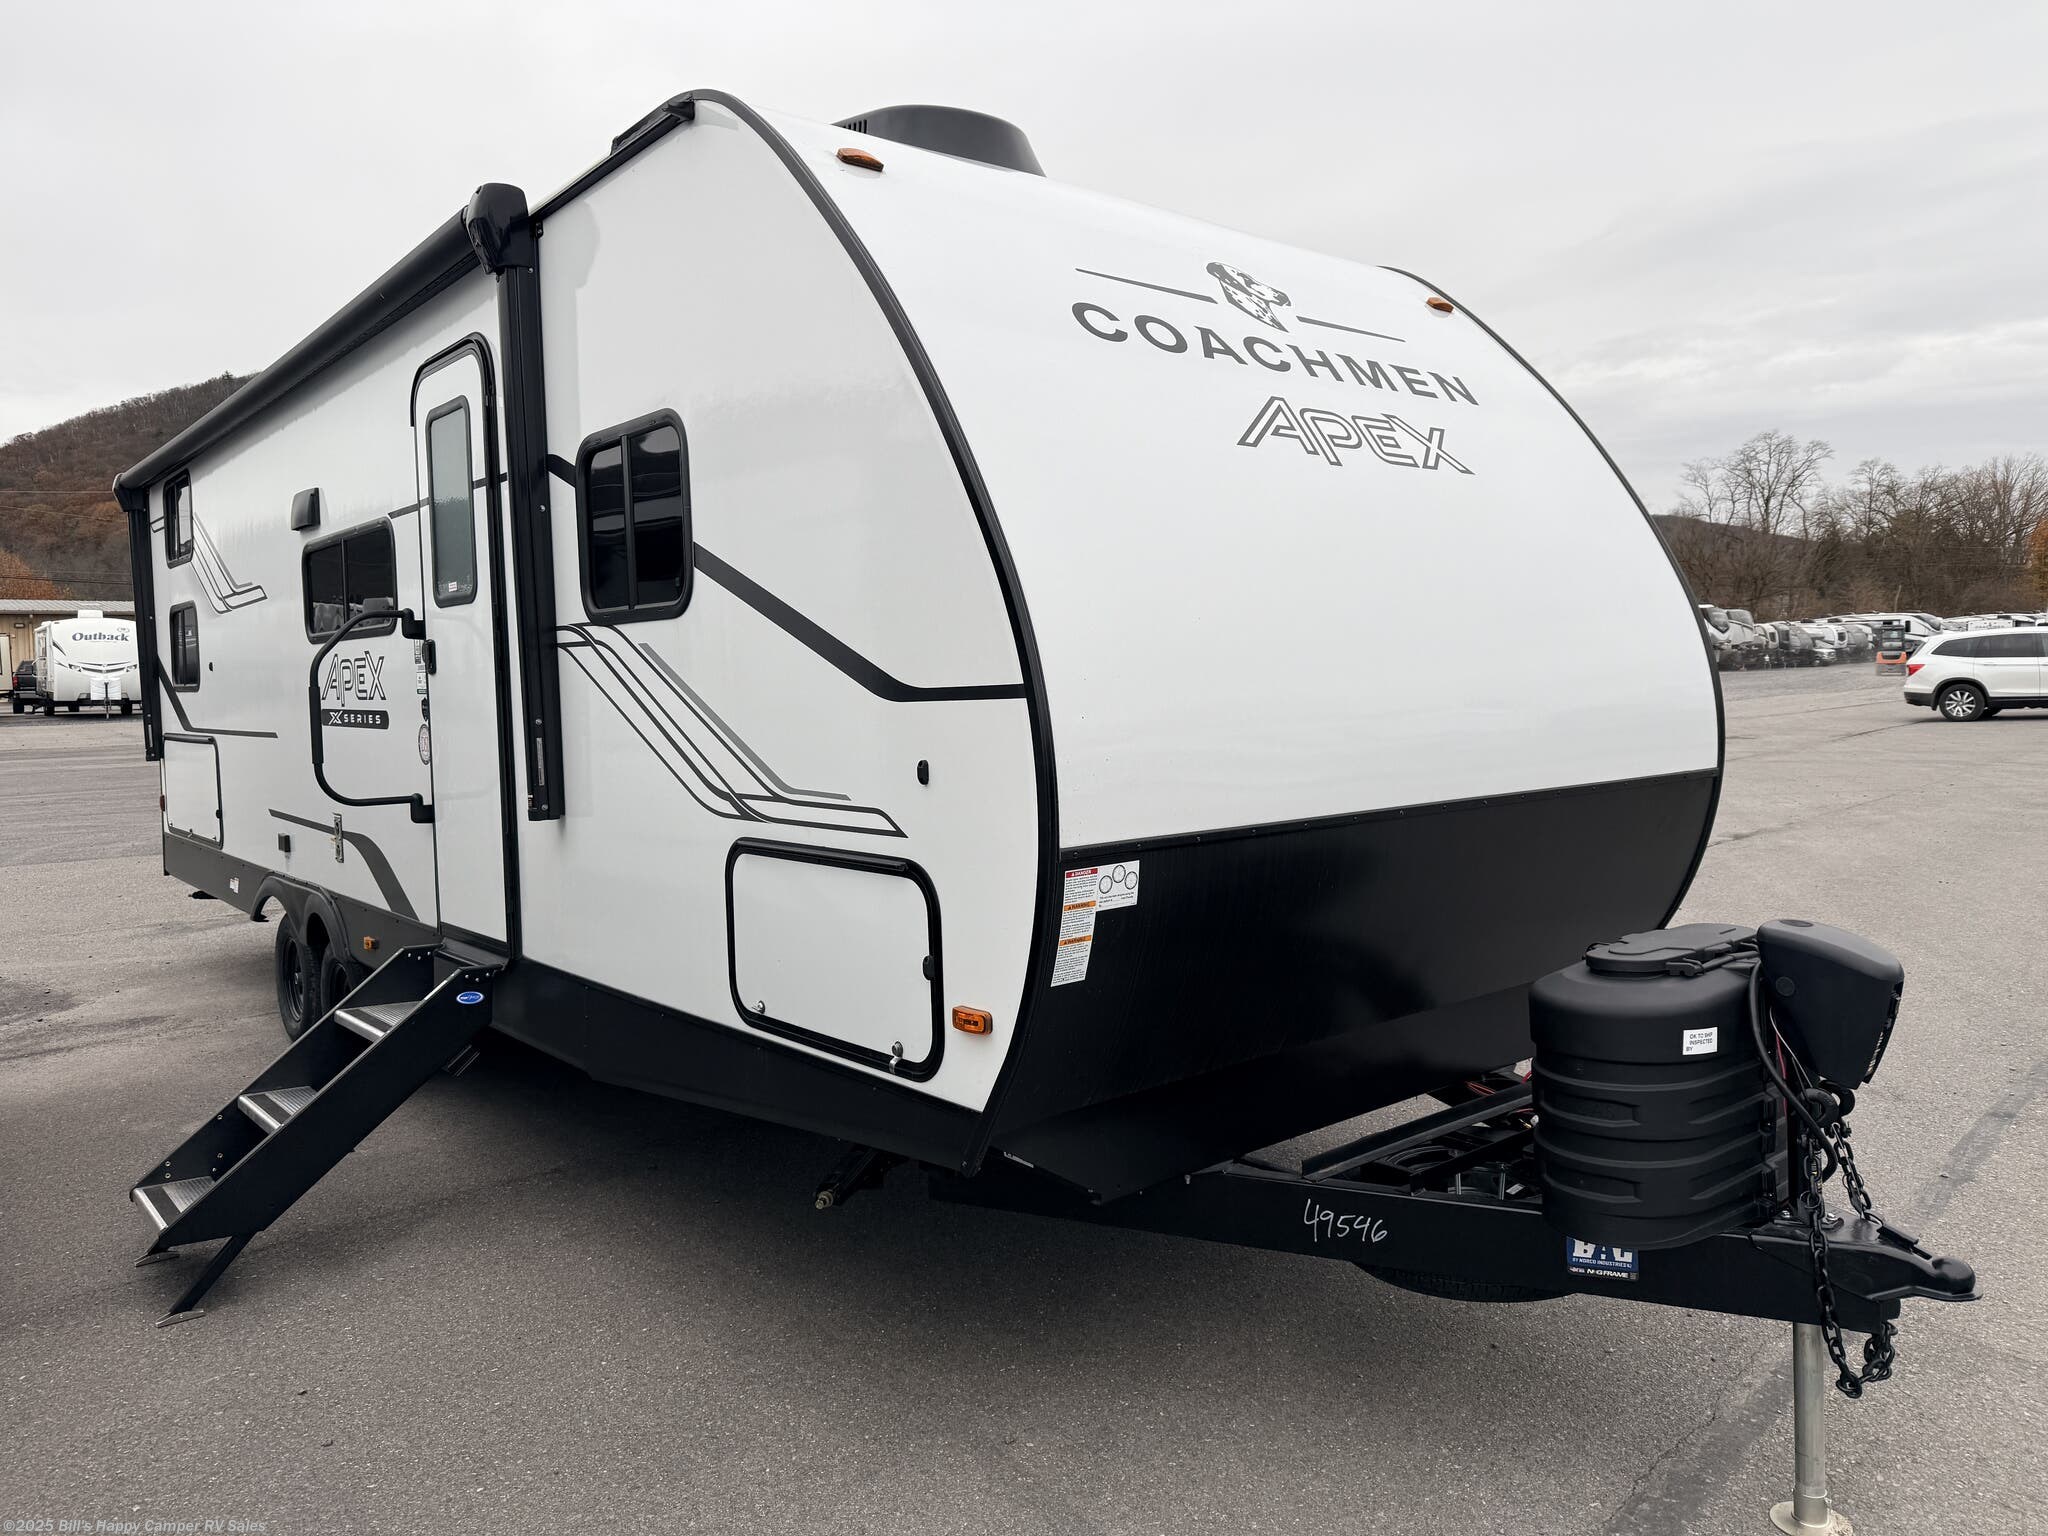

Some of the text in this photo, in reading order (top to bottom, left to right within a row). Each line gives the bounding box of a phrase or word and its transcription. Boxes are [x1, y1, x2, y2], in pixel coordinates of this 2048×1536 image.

[1071, 302, 1480, 406] COACHMEN
[1236, 395, 1477, 475] APEX
[72, 632, 129, 641] Outback
[321, 650, 387, 707] APEX
[343, 713, 381, 725] SERIES
